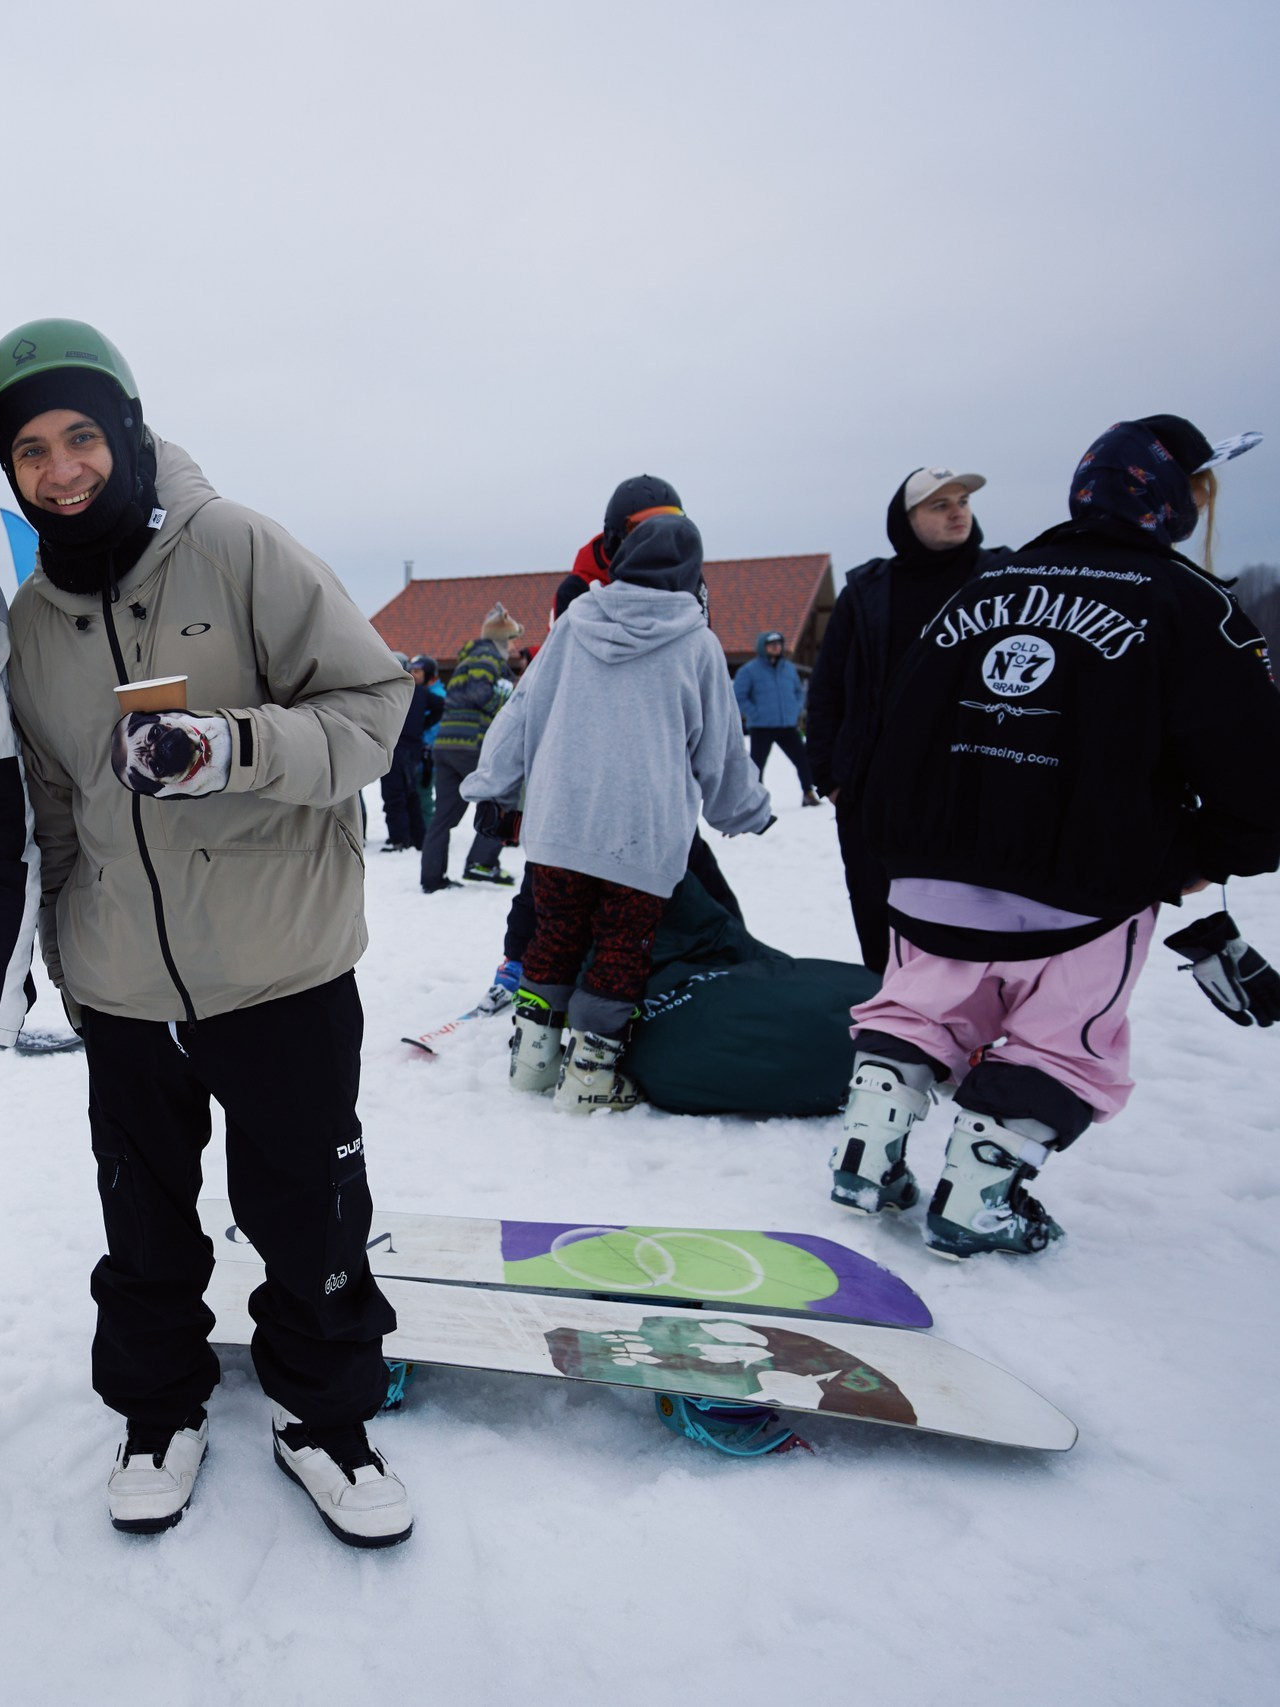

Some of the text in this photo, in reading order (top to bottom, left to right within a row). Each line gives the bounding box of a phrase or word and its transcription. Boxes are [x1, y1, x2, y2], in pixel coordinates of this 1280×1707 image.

[1048, 566, 1078, 577] Drink
[935, 593, 1017, 648] JACK
[1010, 641, 1040, 653] OLD
[578, 1094, 638, 1104] HEAD
